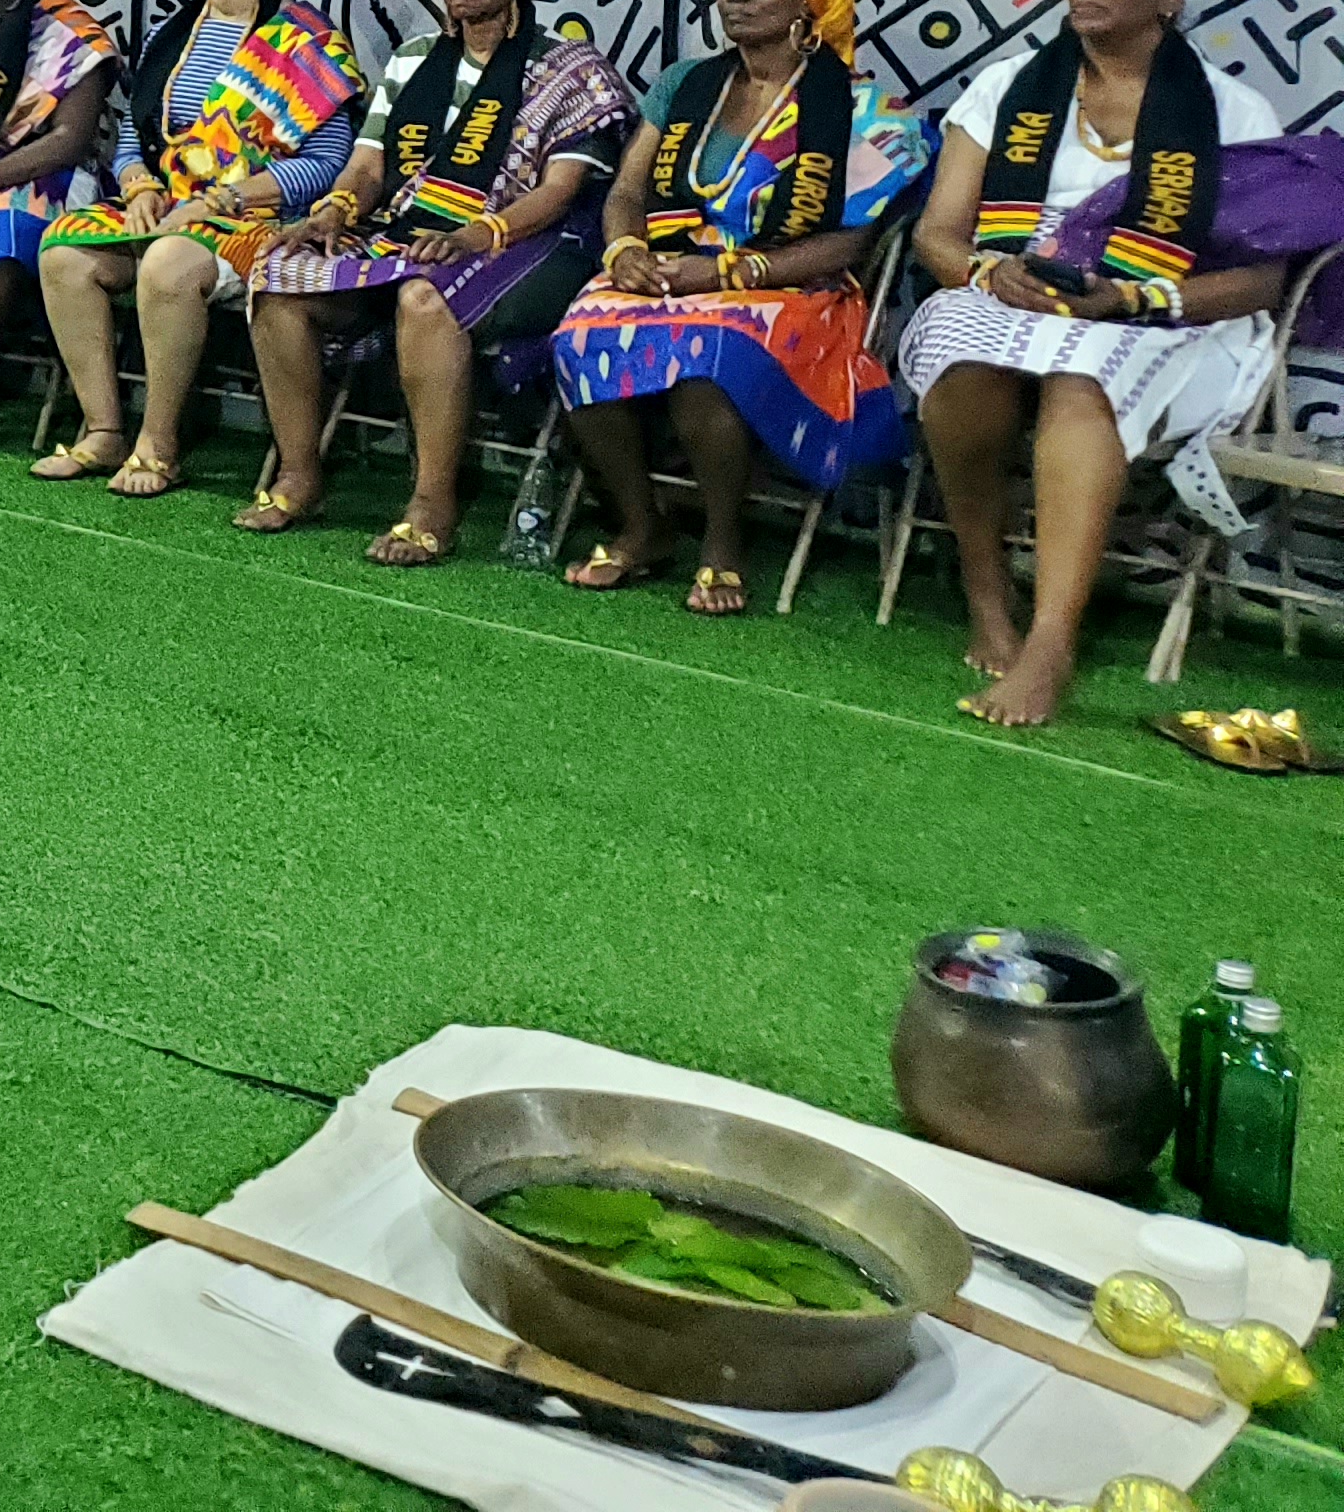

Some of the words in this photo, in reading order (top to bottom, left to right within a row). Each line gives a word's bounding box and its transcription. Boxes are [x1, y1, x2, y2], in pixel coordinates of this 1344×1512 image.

[398, 123, 429, 176] AMA
[450, 99, 502, 165] ANIMA
[653, 122, 693, 197] ABENA
[1005, 112, 1053, 164] AMA
[1137, 151, 1197, 234] SERWAA
